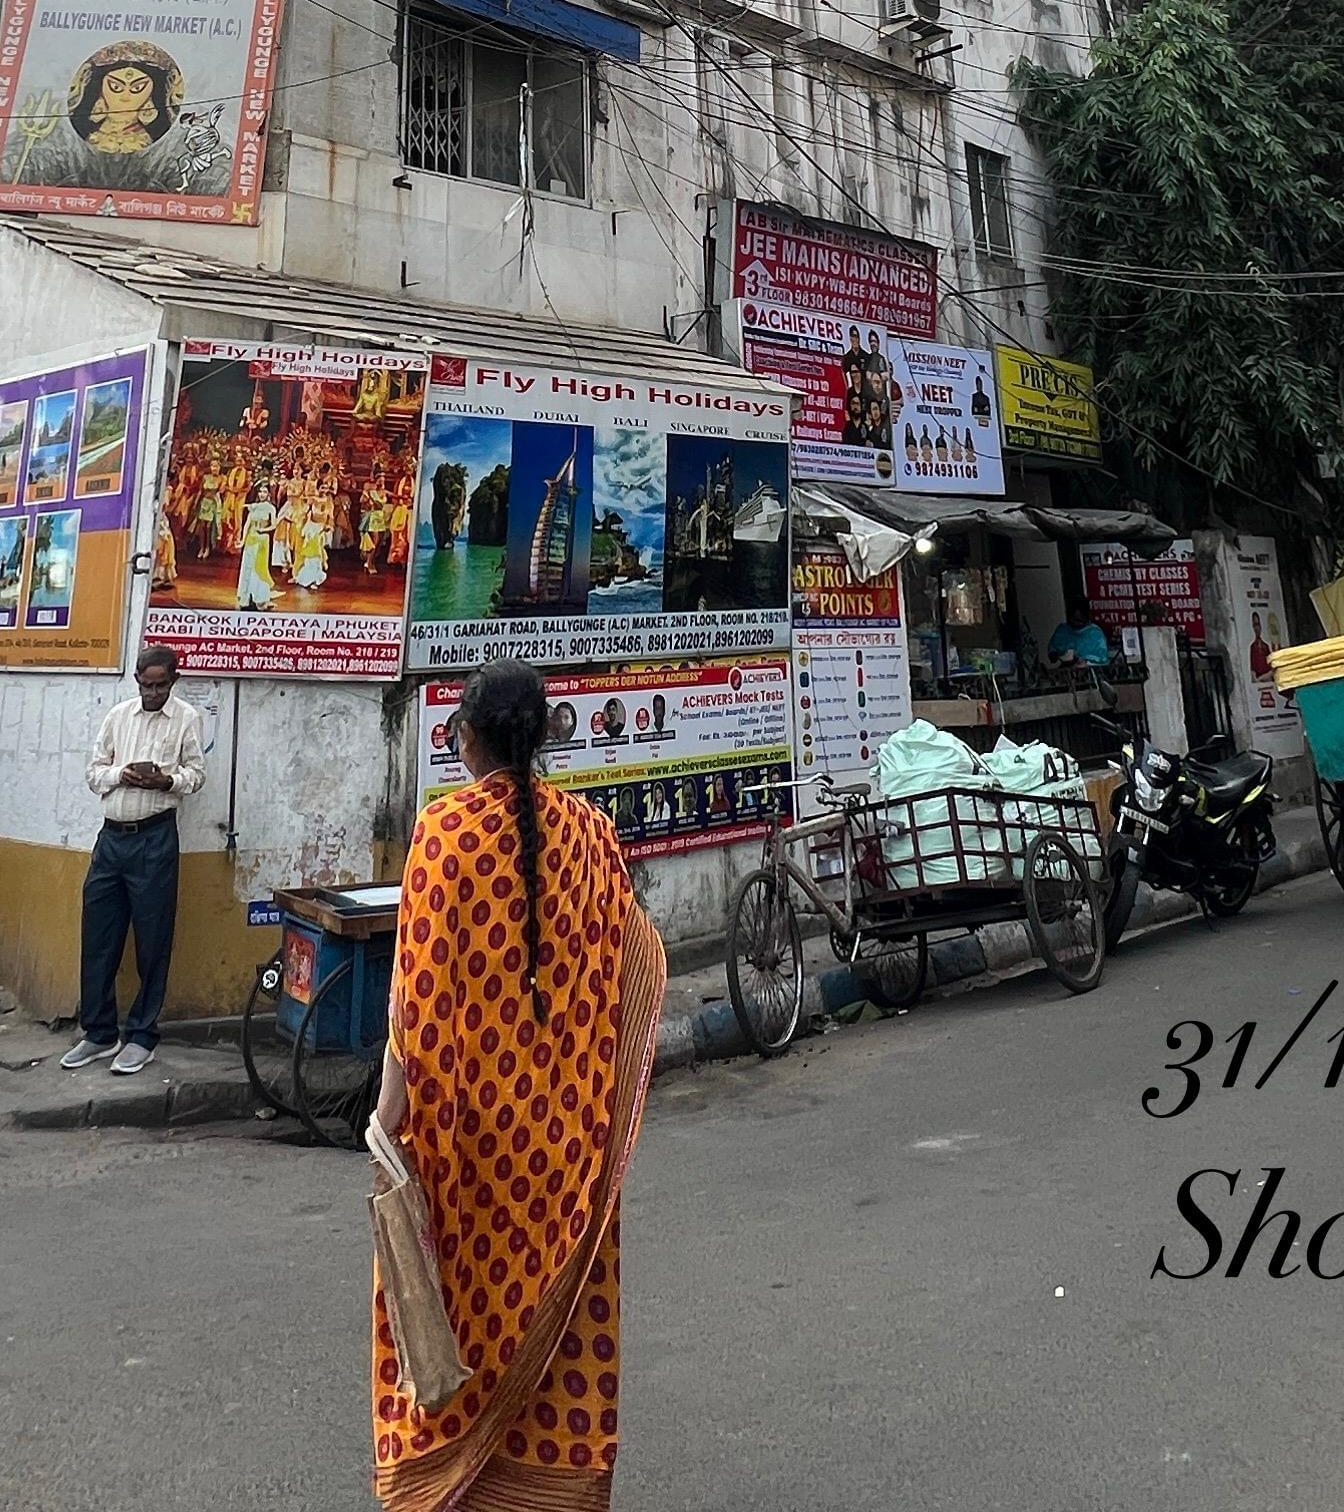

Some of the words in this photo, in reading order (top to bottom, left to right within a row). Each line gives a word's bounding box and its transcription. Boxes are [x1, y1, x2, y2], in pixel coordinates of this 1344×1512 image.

[39, 11, 121, 31] BALLYGUNGE
[124, 14, 151, 32] NEW
[154, 15, 207, 35] MARKET
[209, 17, 242, 40] (A.C.)
[245, 88, 265, 121] NEW
[239, 132, 262, 197] MARKET
[746, 212, 766, 228] AB
[770, 217, 788, 233] Sir
[740, 231, 776, 261] JEE
[782, 239, 840, 275] MAINS
[843, 253, 933, 296] (ADVANCED)
[898, 293, 931, 313] Boards
[757, 308, 844, 341] ACHIEVERS
[211, 344, 247, 359] Fly
[256, 346, 312, 363] High
[322, 350, 425, 369] Holidays
[944, 357, 967, 369] NEET
[272, 362, 287, 372] Fly
[289, 363, 311, 375] High
[314, 365, 355, 377] Holidays
[476, 368, 535, 393] Fly
[551, 377, 636, 402] High
[648, 382, 785, 417] Holidays
[921, 383, 954, 404] NEET
[433, 401, 505, 416] THAILAND
[533, 410, 580, 423] DUBAI
[613, 417, 649, 428] BALI
[670, 421, 731, 436] SINGAPORE
[745, 429, 787, 441] CRUISE
[915, 463, 978, 479] 9874931106
[1098, 567, 1147, 581] CHEMISRY
[1149, 566, 1189, 580] CLASSES
[1136, 583, 1157, 596] TEST
[1160, 582, 1190, 596] SERIES
[820, 592, 874, 616] POINTS
[145, 623, 193, 635] KRABI
[208, 626, 306, 639] SINGAPORE
[321, 630, 403, 642] MALAYSIA
[148, 613, 231, 627] BANGKOK
[247, 617, 321, 629] PATTAYA
[335, 620, 399, 631] PHUKET
[410, 624, 449, 640] 46/31/1
[453, 622, 506, 638] GARIAHAT
[509, 621, 539, 637] ROAD,
[542, 618, 605, 633] BALLYGUNGE
[670, 614, 688, 628] 2ND
[690, 613, 719, 629] FLOOR,
[721, 612, 743, 626] ROOM
[199, 642, 214, 652] AC
[217, 643, 253, 654] Market,
[255, 644, 274, 655] 2nd
[306, 646, 335, 656] Room
[337, 647, 354, 656] No.
[429, 643, 479, 665] Mobile:
[483, 639, 566, 660] 9007228315,
[570, 679, 579, 690] to
[743, 672, 782, 684] ACHIEVERS
[682, 693, 733, 708] ACHIEVERS
[734, 691, 759, 705] Mock
[760, 689, 784, 703] Tests
